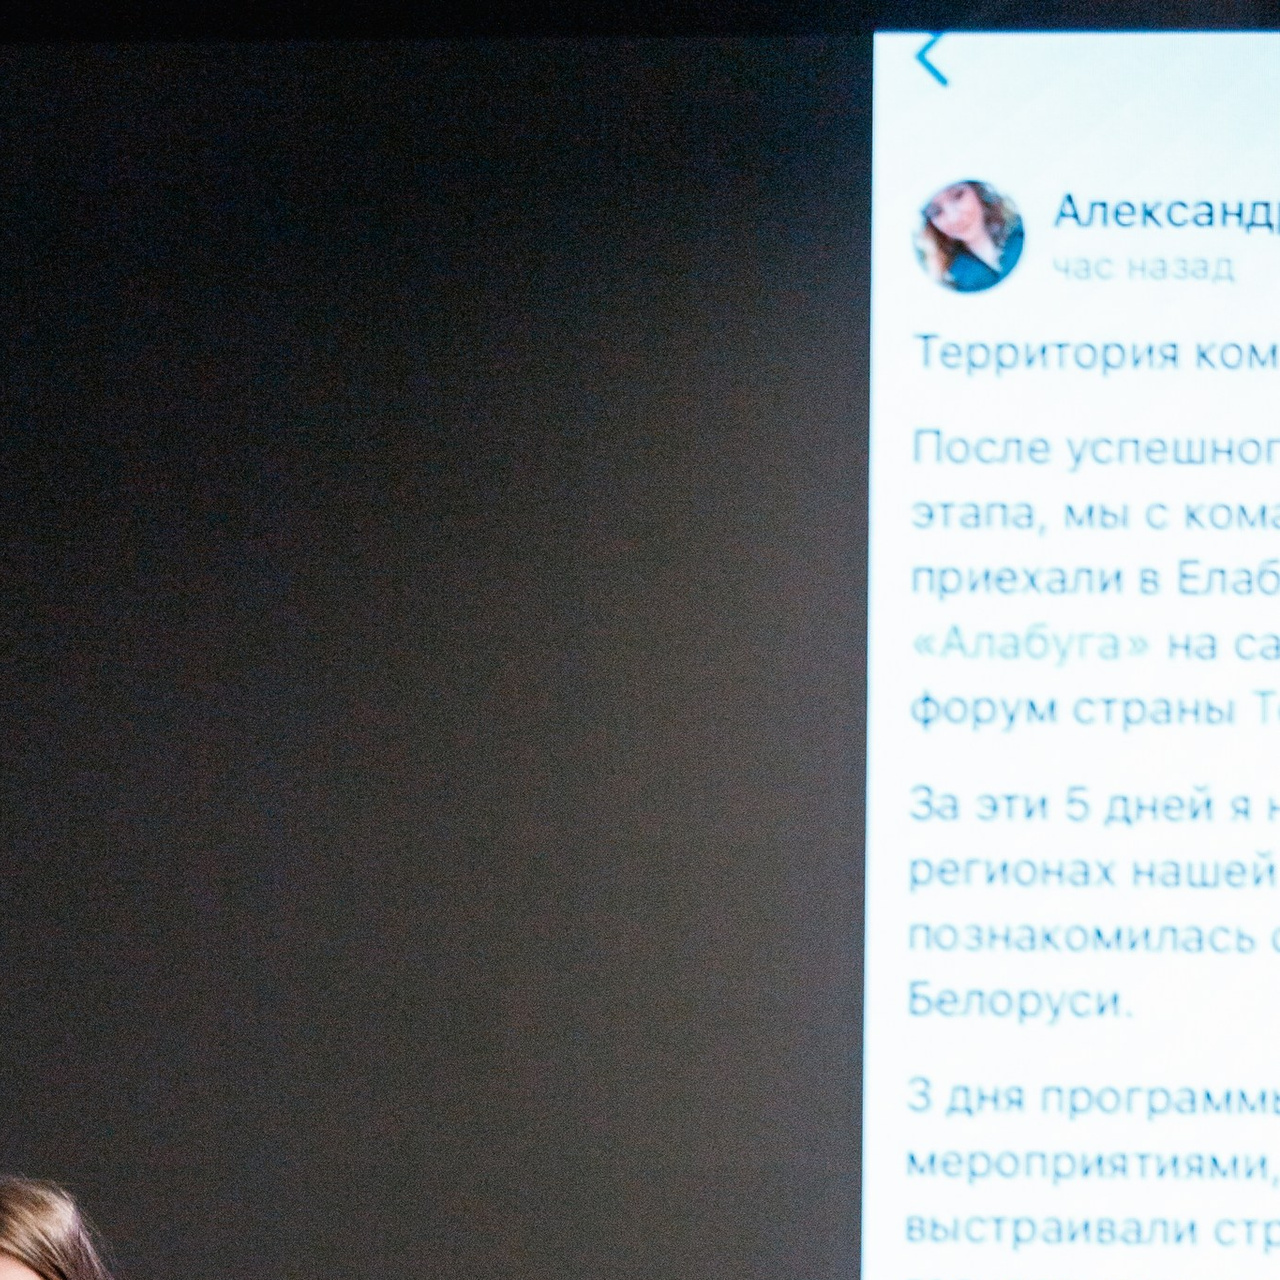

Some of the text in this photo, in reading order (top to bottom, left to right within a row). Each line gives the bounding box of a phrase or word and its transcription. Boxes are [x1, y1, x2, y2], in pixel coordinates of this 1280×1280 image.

[1052, 191, 1280, 236] Александ
[1053, 257, 1237, 284] час назад
[913, 332, 1180, 378] Территория
[913, 427, 1052, 466] После
[913, 501, 1046, 536] этапа,
[1064, 503, 1129, 530] мы
[1145, 502, 1168, 531] с
[912, 558, 1280, 602] приехали в Елаб
[913, 621, 1280, 668] «Алабуга» на са
[910, 688, 1280, 733] форум страны Т
[910, 783, 960, 822] За
[976, 793, 1049, 822] эти
[1065, 784, 1091, 823] 5
[1103, 785, 1214, 828] дней
[1230, 795, 1252, 821] я
[909, 851, 1277, 893] регионах нашей
[909, 923, 1257, 955] познакомилась
[908, 979, 1132, 1026] Белоруси.
[908, 1075, 933, 1114] 3
[945, 1084, 1025, 1118] дня
[906, 1150, 1280, 1188] мероприятиями,
[905, 1215, 1198, 1251] выстраивали
